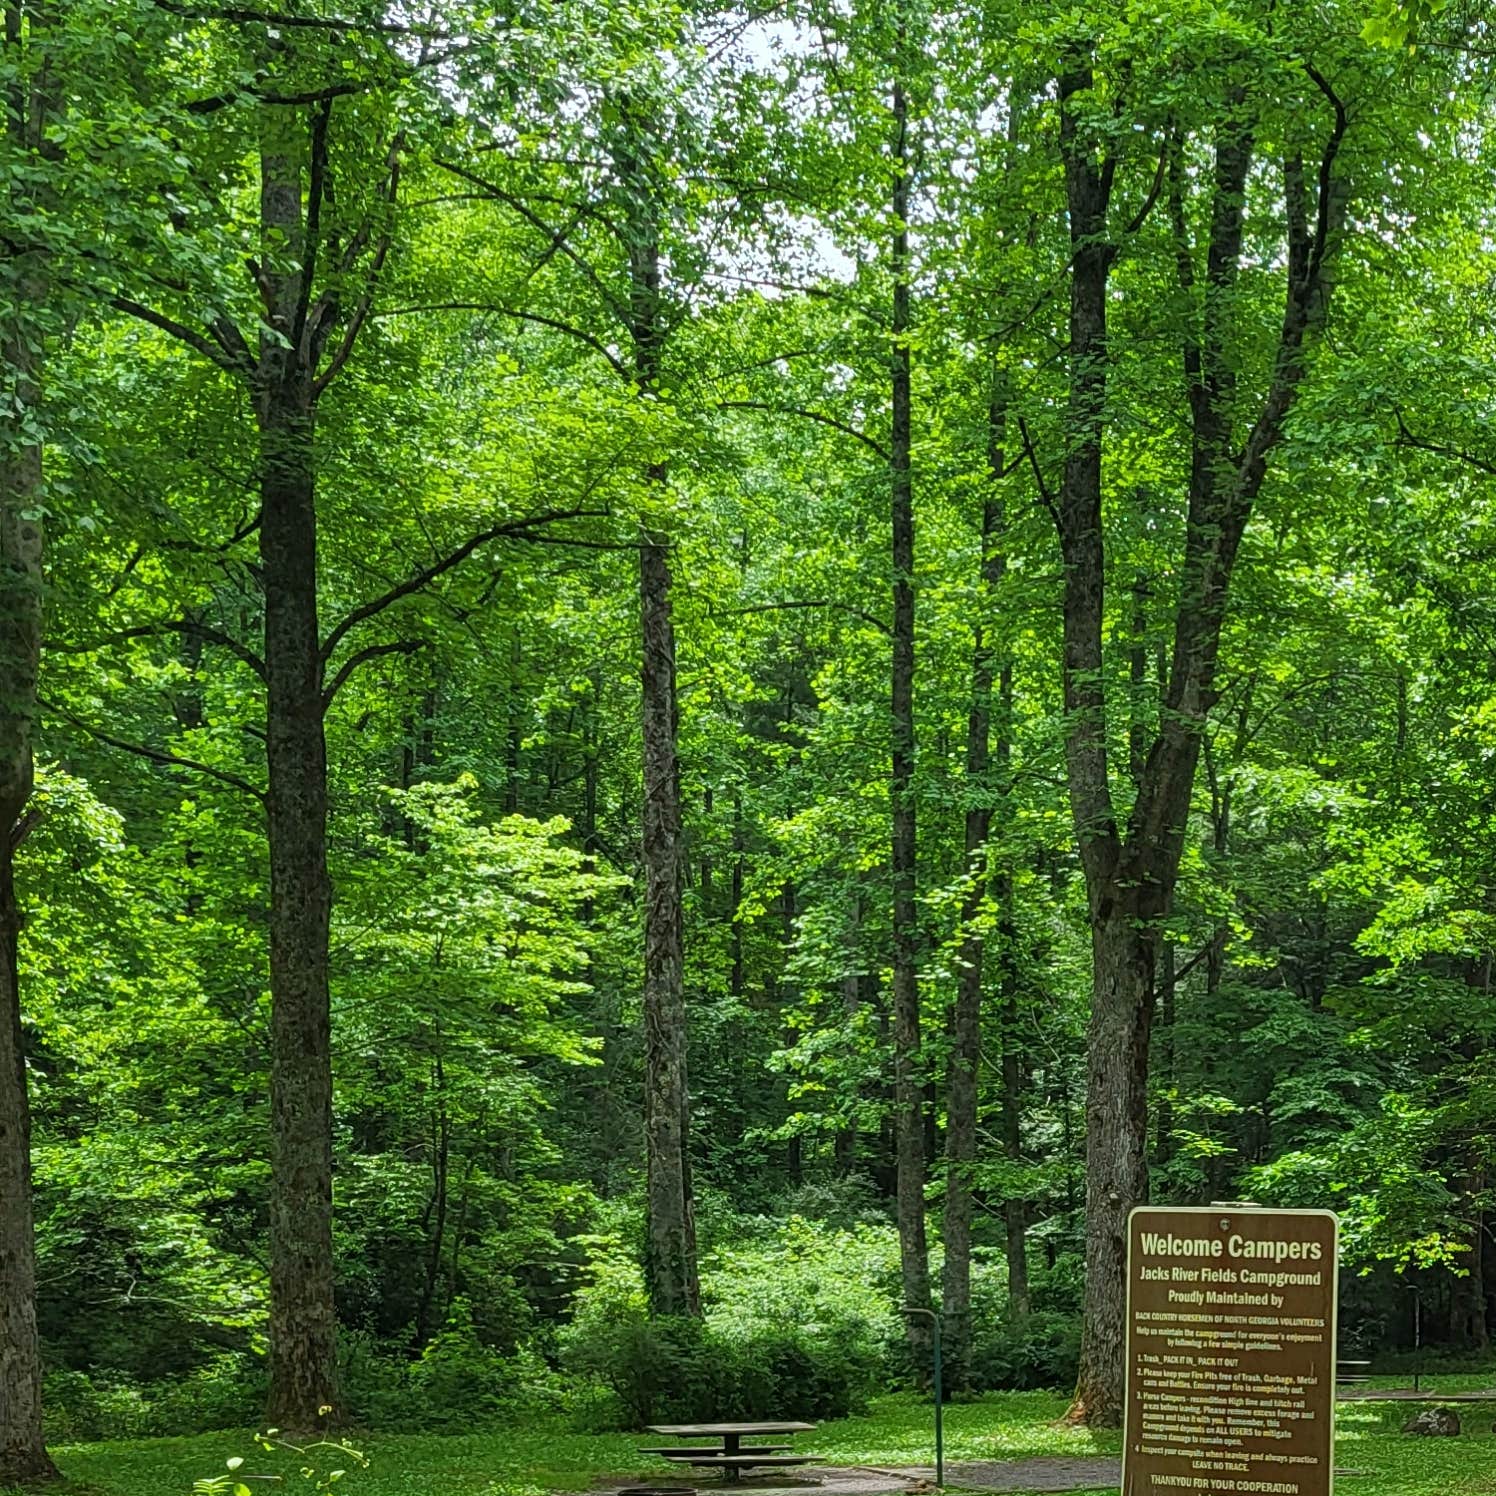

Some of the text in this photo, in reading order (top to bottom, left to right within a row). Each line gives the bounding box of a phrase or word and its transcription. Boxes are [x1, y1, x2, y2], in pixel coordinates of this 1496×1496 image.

[1141, 1233, 1322, 1263] Welcome Campers
[1140, 1266, 1321, 1287] Jacks River Fields Campground
[1168, 1290, 1284, 1308] Proudly Maintained by
[1136, 1311, 1150, 1320] BACK
[1152, 1313, 1177, 1321] COUNTRY
[1179, 1314, 1214, 1322] HORSEMEN
[1215, 1315, 1223, 1323] OF
[1248, 1316, 1279, 1325] GEORGIA
[1280, 1317, 1325, 1327] VOLUNTEERS
[1136, 1326, 1149, 1336] Help
[1159, 1328, 1183, 1336] maintain
[1196, 1331, 1236, 1339] campground
[1249, 1332, 1284, 1340] everyone's
[1286, 1333, 1322, 1343] enjoyment
[1168, 1338, 1174, 1347] by
[1175, 1339, 1202, 1349] following
[1209, 1340, 1220, 1348] few
[1222, 1340, 1244, 1350] simple
[1164, 1356, 1178, 1364] PACK
[1179, 1356, 1185, 1364] IT
[1198, 1357, 1216, 1365] PACK
[1217, 1358, 1223, 1366] IT
[1224, 1358, 1238, 1367] OUT
[1136, 1368, 1143, 1376] 2.
[1144, 1368, 1162, 1376] Please
[1164, 1369, 1177, 1378] keep
[1178, 1371, 1190, 1380] your
[1192, 1371, 1203, 1379] Fire
[1205, 1372, 1217, 1380] Pits
[1219, 1372, 1232, 1380] free
[1297, 1376, 1318, 1384] Metal
[1193, 1381, 1215, 1389] Ensure
[1216, 1384, 1231, 1392] your
[1232, 1383, 1244, 1391] fire
[1253, 1385, 1290, 1395] completely
[1143, 1392, 1159, 1400] Horse
[1161, 1393, 1185, 1402] Campers
[1229, 1397, 1244, 1406] High
[1260, 1399, 1273, 1407] and
[1293, 1400, 1305, 1408] rail
[1178, 1414, 1190, 1422] take
[1197, 1415, 1211, 1423] with
[1267, 1419, 1280, 1427] this
[1203, 1406, 1226, 1414] Please
[1277, 1409, 1300, 1419] forage
[1301, 1411, 1314, 1419] and
[1143, 1422, 1179, 1431] Campground
[1180, 1424, 1204, 1433] depends
[1230, 1428, 1253, 1436] USERS
[1263, 1430, 1292, 1439] mitigate
[1192, 1435, 1198, 1443] to
[1142, 1445, 1163, 1454] Inspect
[1165, 1448, 1177, 1456] your
[1206, 1450, 1224, 1458] when
[1225, 1451, 1249, 1461] leaving
[1265, 1454, 1288, 1463] always
[1289, 1456, 1318, 1464] practice
[1193, 1478, 1209, 1488] FOR
[1210, 1479, 1235, 1490] YOUR
[1237, 1481, 1298, 1494] COOPERATION
